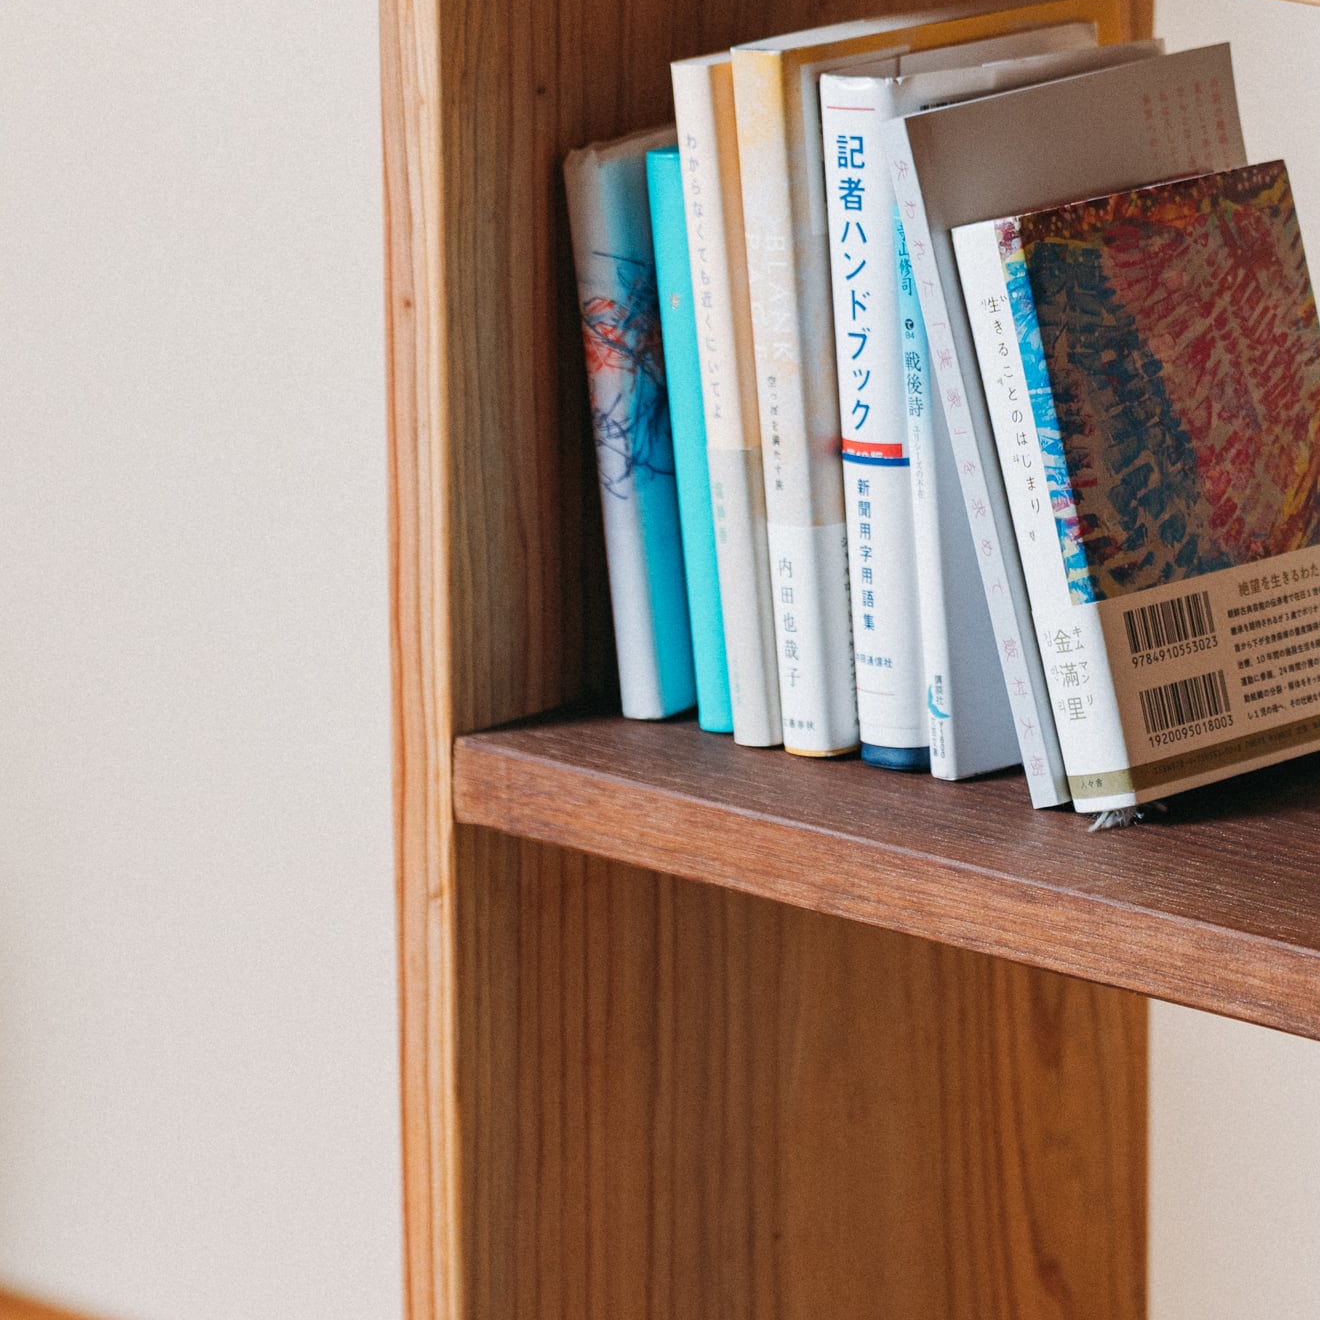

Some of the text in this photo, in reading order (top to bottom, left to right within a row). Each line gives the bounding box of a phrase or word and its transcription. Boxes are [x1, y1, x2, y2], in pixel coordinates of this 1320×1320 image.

[834, 134, 874, 430] 記者ハンドブック
[904, 351, 924, 417] 戦後詩
[857, 479, 876, 631] 新聞用字用語集
[778, 556, 802, 688] 内田也哉子
[1131, 635, 1219, 668] 9784910553023
[1148, 714, 1235, 748] 1920095018003
